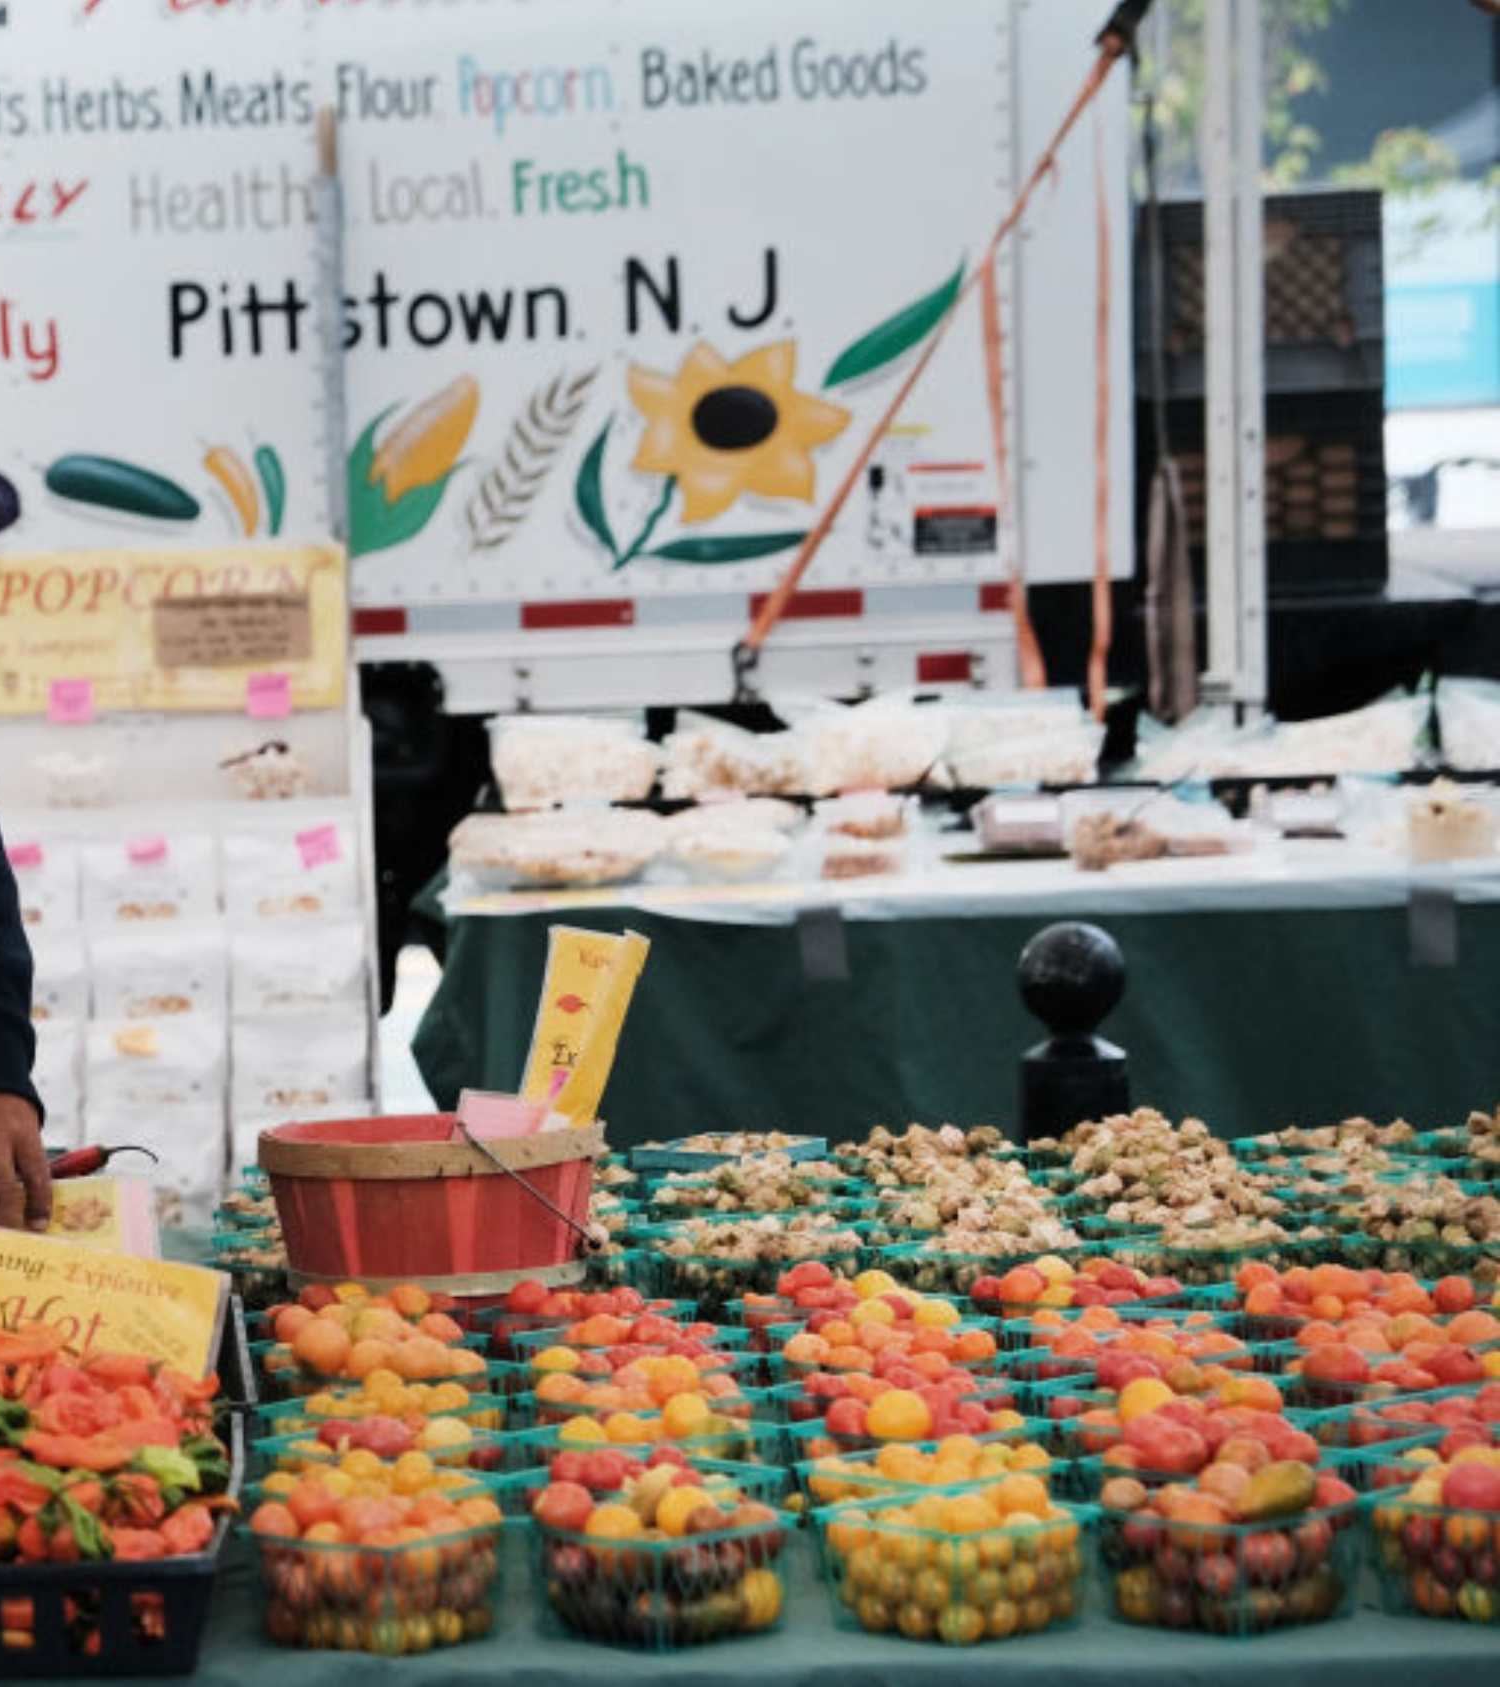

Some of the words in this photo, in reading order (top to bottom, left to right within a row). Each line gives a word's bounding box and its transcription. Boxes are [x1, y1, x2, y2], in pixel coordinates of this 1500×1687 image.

[641, 46, 778, 108] Baked
[790, 38, 929, 100] Goods
[511, 148, 651, 215] Fresh
